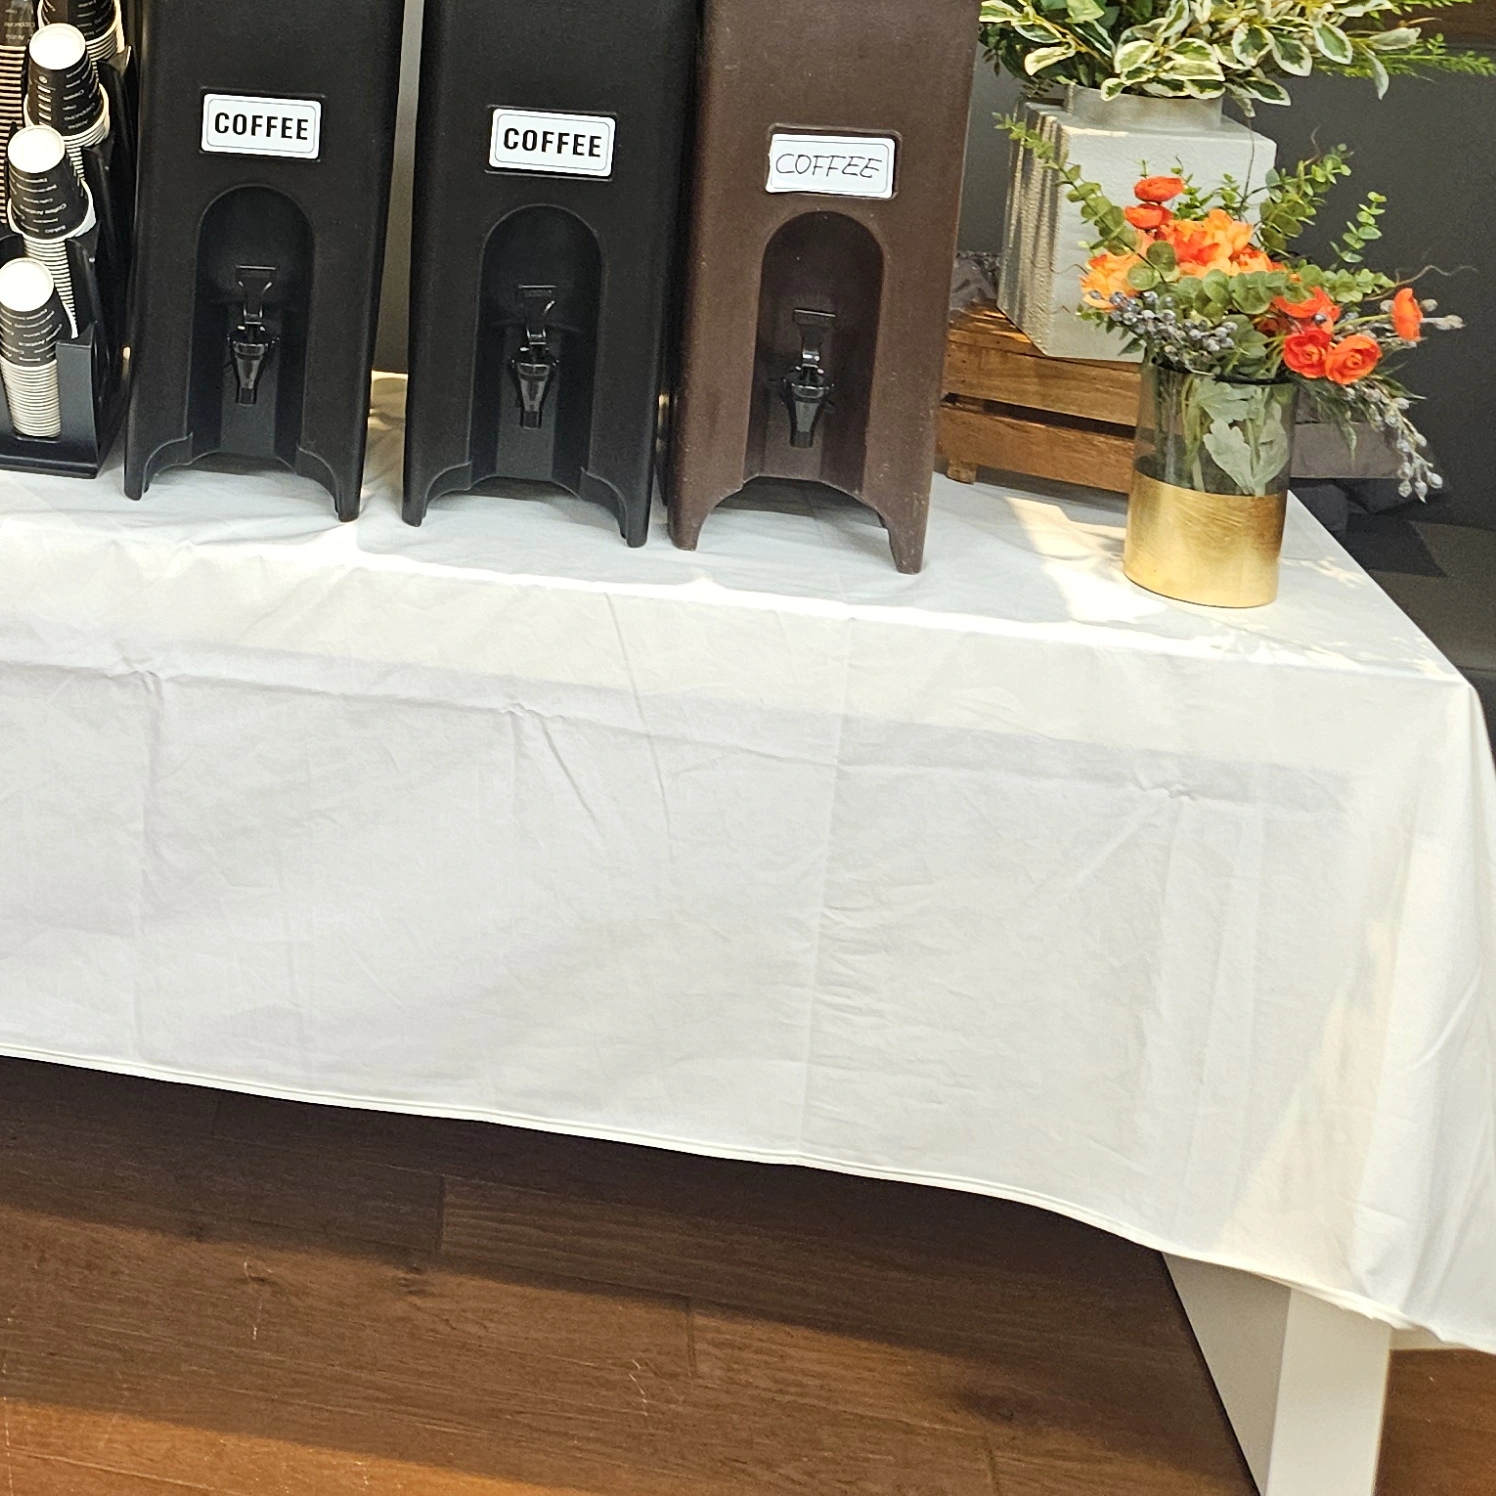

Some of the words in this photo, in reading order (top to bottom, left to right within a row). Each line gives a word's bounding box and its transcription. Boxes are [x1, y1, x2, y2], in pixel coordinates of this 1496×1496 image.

[214, 111, 309, 141] COFFEE
[503, 126, 603, 158] COFFEE
[775, 152, 883, 179] COFFEE
